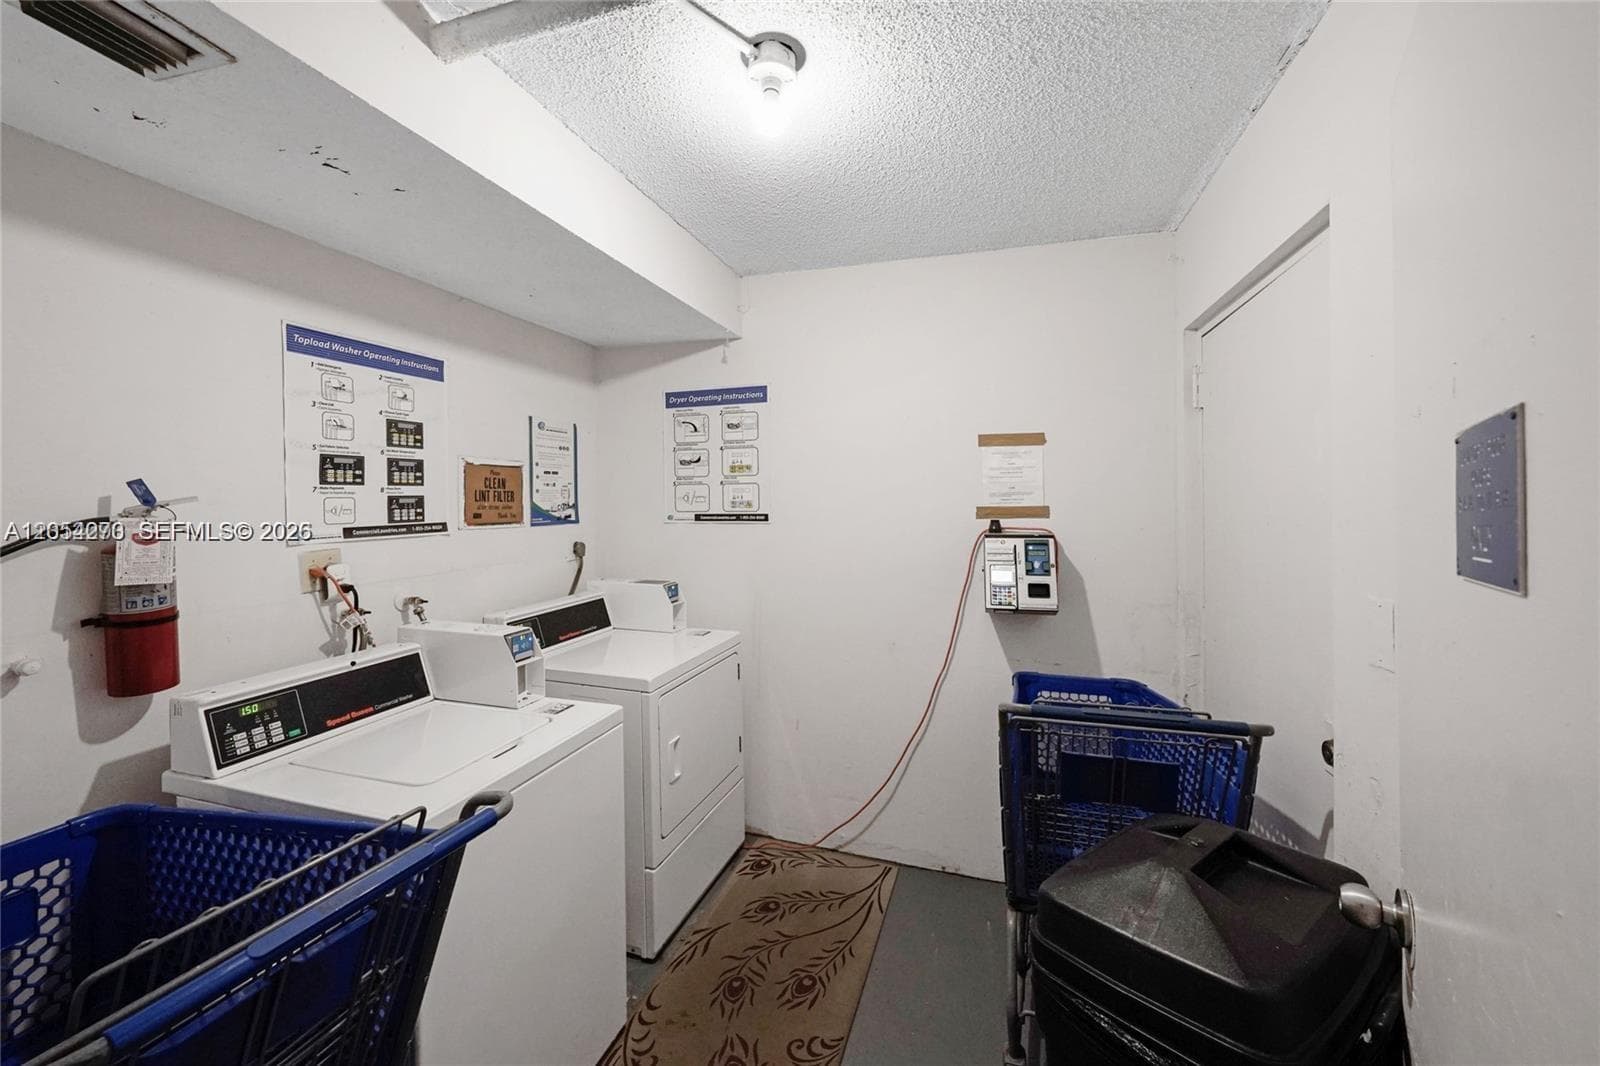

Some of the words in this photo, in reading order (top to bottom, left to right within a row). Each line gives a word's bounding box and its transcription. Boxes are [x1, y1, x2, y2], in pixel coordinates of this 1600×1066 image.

[293, 334, 330, 349] Topload
[331, 343, 362, 357] Washer
[363, 350, 400, 366] Operating
[401, 359, 440, 374] Instructions
[669, 397, 688, 405] Dryer
[688, 395, 721, 403] Operating
[722, 391, 764, 400] Instructions
[484, 477, 506, 489] CLEAN
[474, 490, 490, 502] LINT
[493, 490, 515, 503] FILTER
